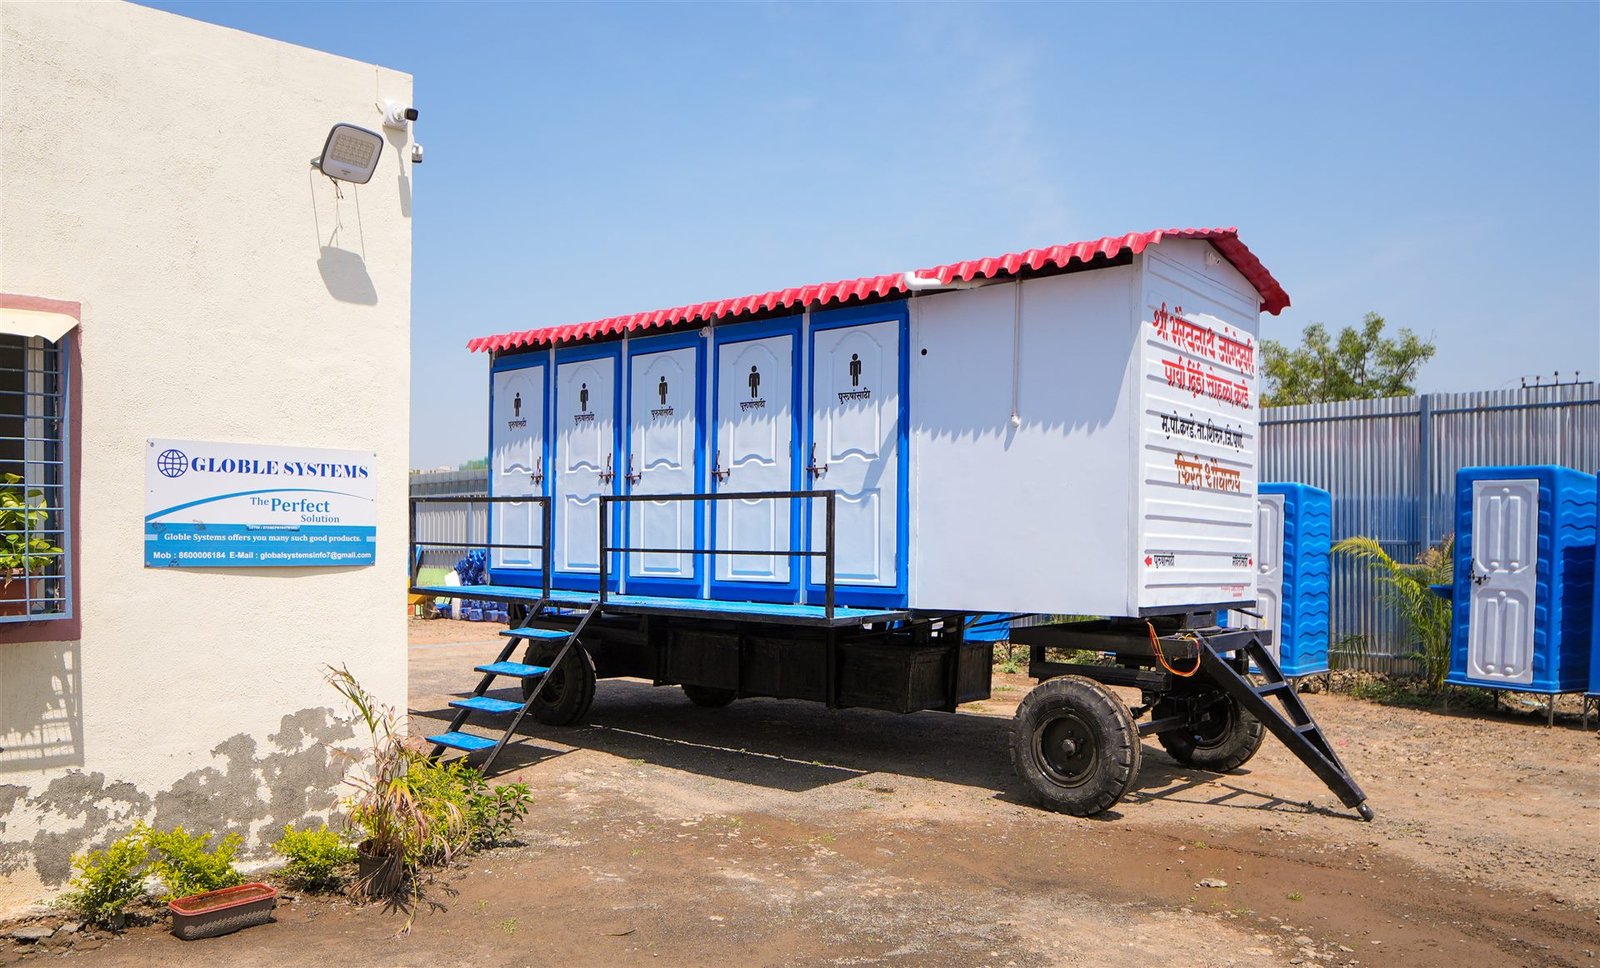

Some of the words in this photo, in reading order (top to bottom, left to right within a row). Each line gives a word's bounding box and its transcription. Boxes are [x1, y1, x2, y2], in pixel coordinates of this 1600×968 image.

[191, 456, 279, 475] GLOBLE
[283, 461, 369, 479] SYSTEMS
[250, 497, 269, 506] The
[271, 498, 330, 513] Perfect
[301, 514, 340, 523] Solution
[164, 533, 191, 541] Globle
[193, 533, 226, 542] Systems
[227, 533, 251, 541] offers
[309, 535, 327, 543] good
[328, 535, 362, 543] products.
[153, 551, 171, 559] Mob
[229, 551, 254, 559] E-Mail
